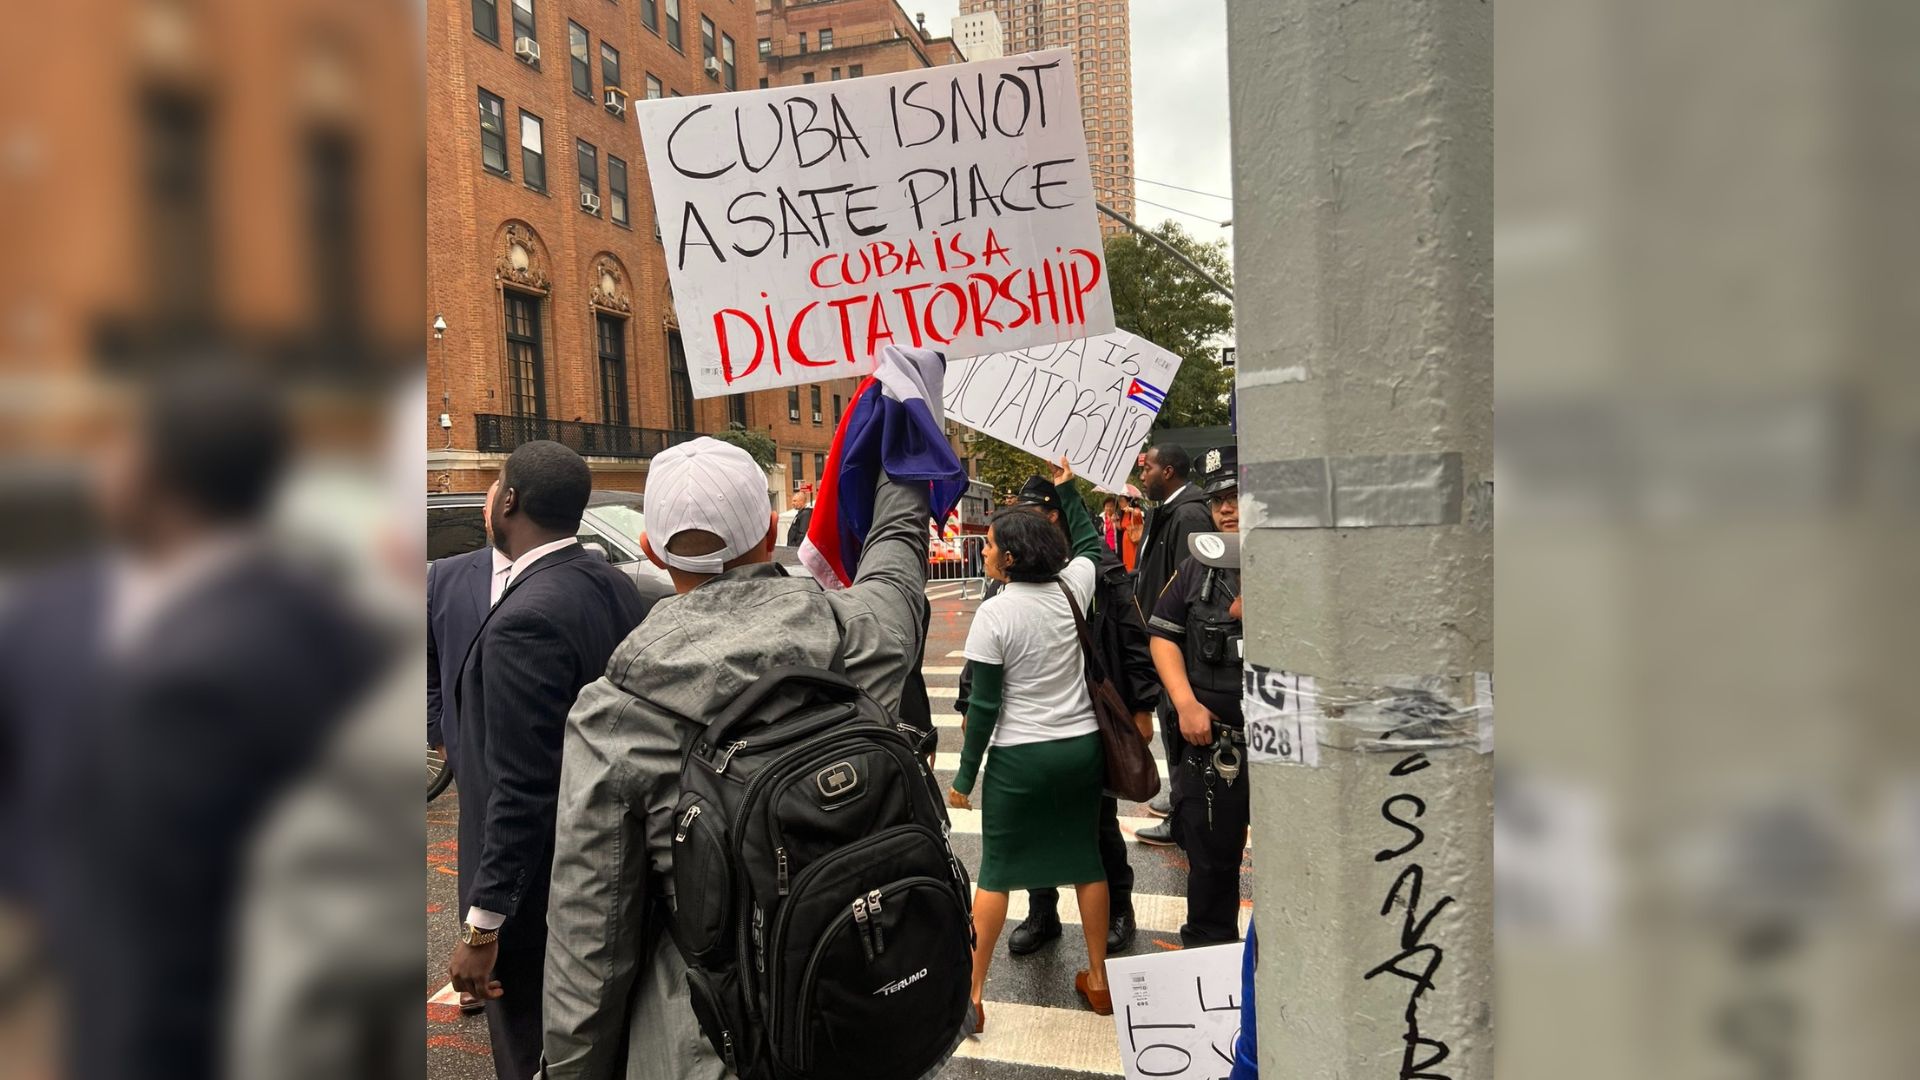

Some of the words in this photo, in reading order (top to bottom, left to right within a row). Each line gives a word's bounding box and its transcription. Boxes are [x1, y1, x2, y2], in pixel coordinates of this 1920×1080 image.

[668, 93, 870, 180] CUBA
[810, 239, 925, 289] CUBA
[982, 227, 1012, 267] A
[1105, 376, 1126, 407] A
[873, 968, 928, 996] TERUMO
